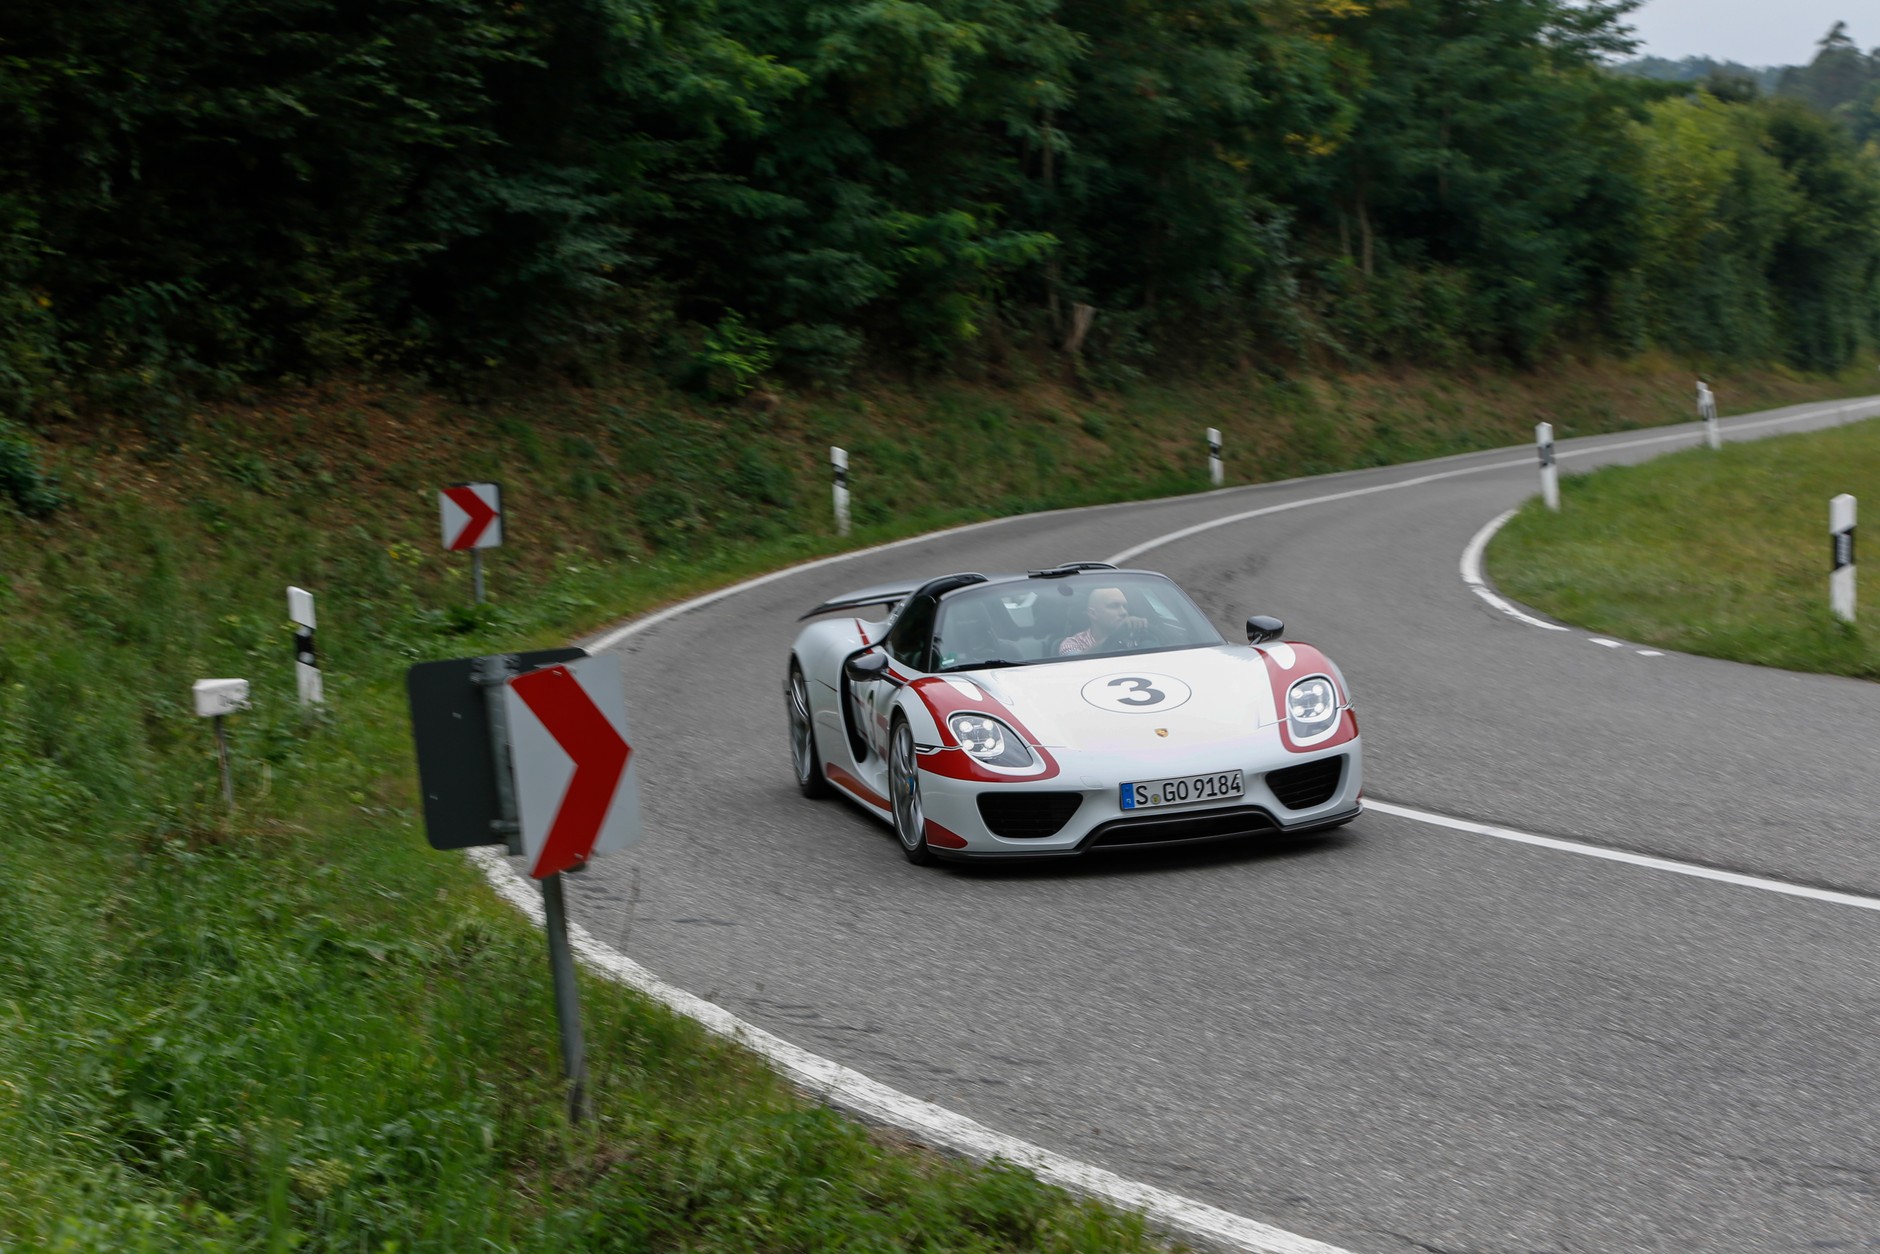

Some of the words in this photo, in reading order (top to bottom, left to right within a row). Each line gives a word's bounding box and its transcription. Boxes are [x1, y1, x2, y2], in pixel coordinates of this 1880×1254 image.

[1107, 677, 1166, 706] 3
[1135, 785, 1149, 805] S
[1162, 780, 1189, 802] GO
[1193, 773, 1241, 798] 9184
